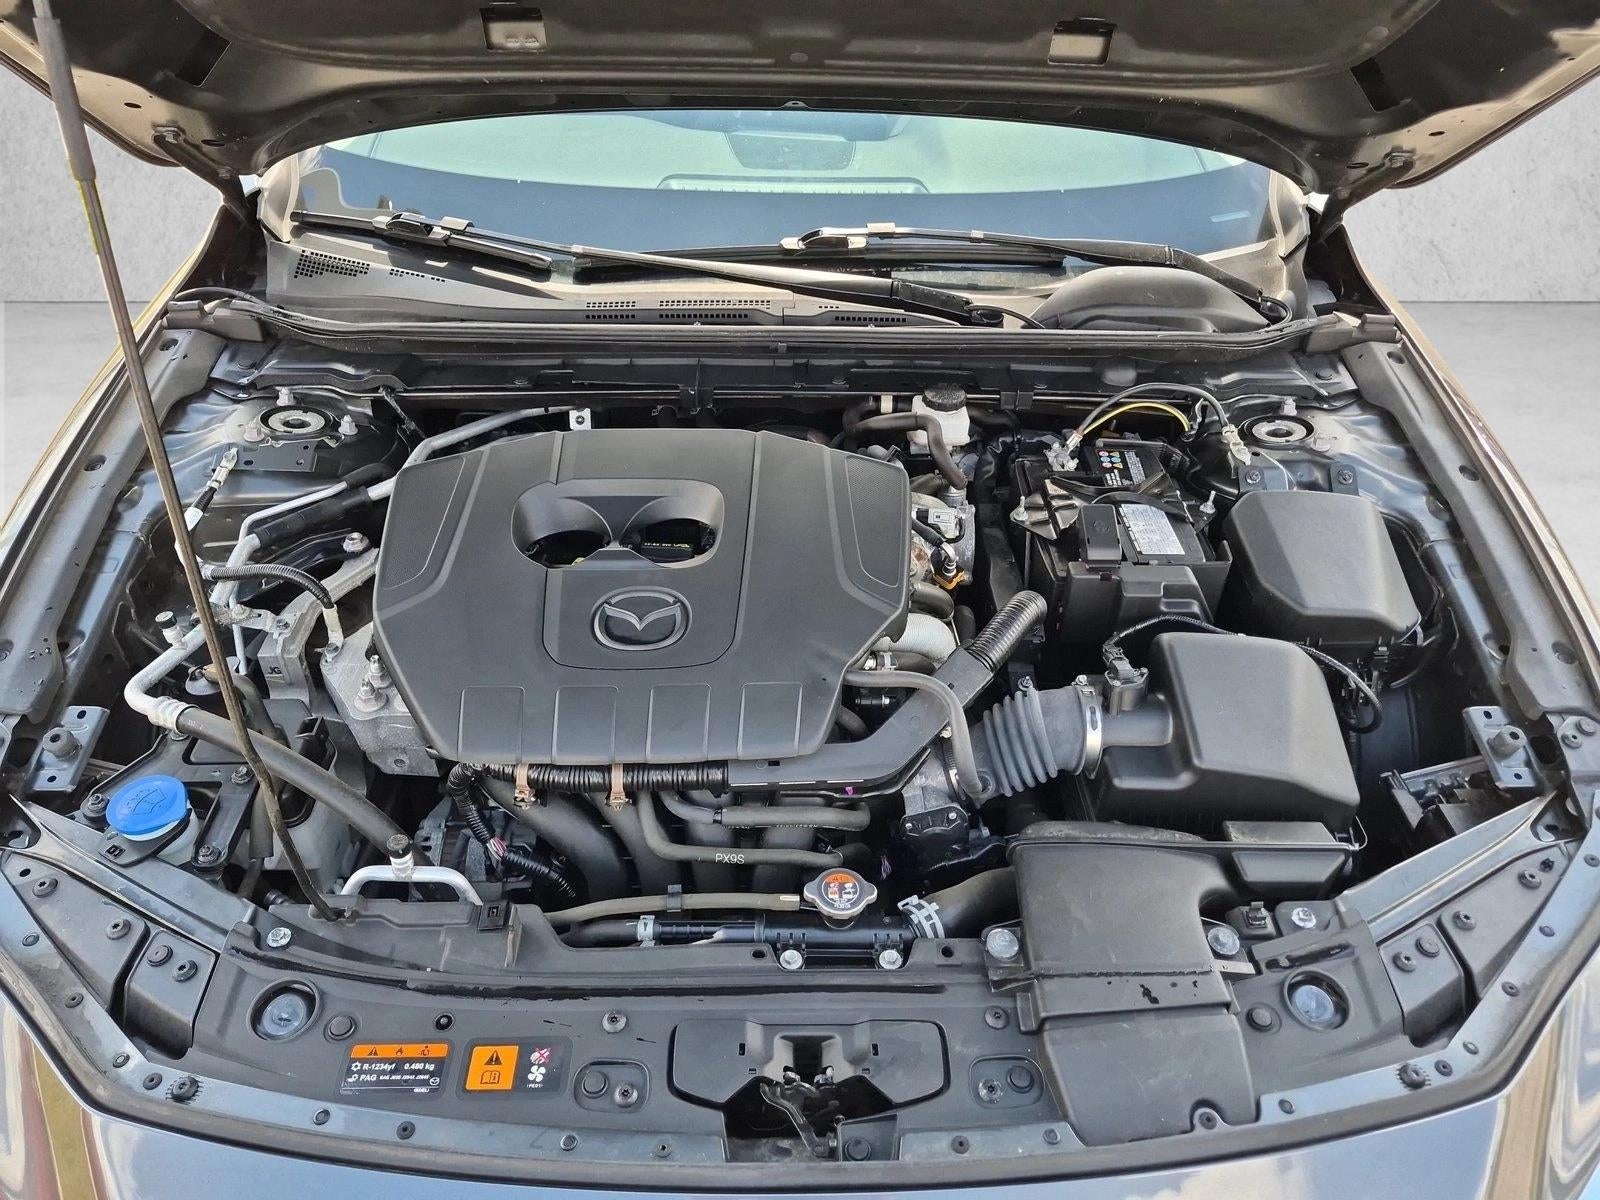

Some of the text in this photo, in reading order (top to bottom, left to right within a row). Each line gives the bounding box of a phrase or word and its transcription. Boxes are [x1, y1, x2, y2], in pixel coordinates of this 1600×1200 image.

[715, 853, 745, 864] PX9S
[425, 1062, 435, 1071] kg
[359, 1074, 377, 1082] PAG
